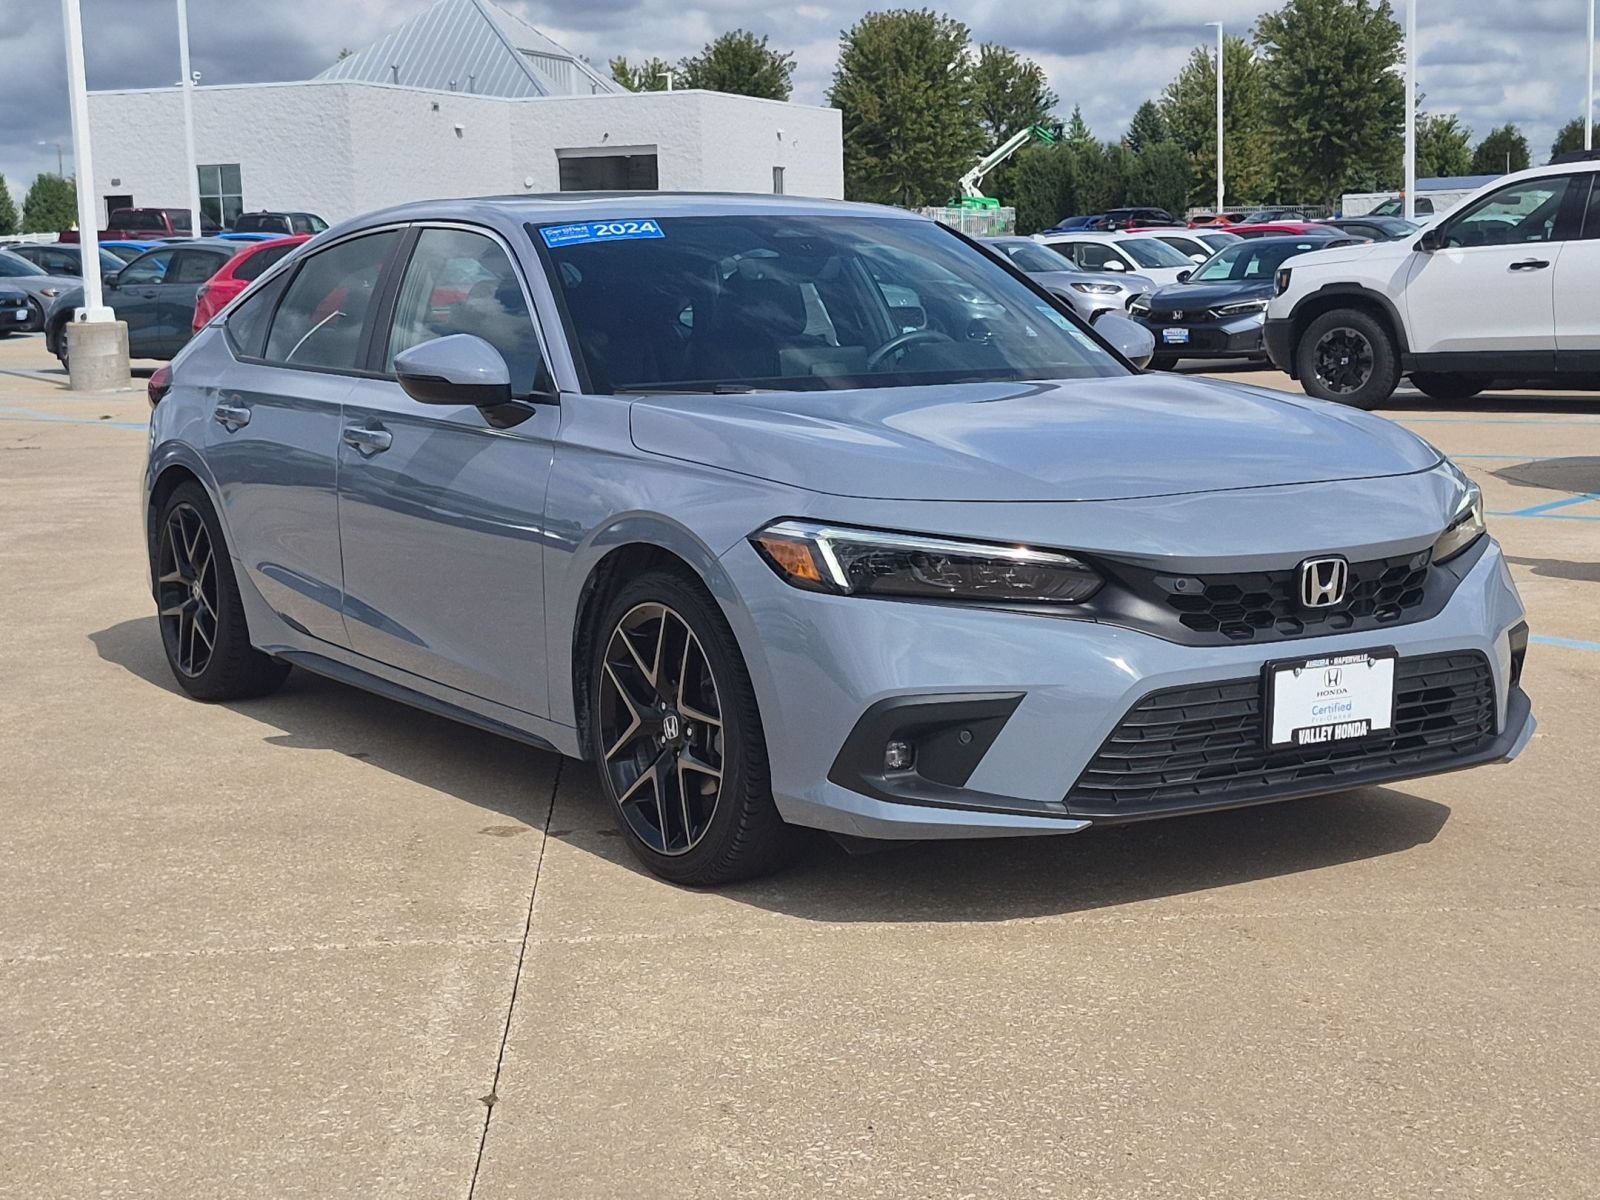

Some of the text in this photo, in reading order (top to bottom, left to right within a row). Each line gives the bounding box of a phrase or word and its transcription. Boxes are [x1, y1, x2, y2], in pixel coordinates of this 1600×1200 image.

[593, 222, 656, 236] 2024
[1316, 688, 1348, 697] HONDA
[1312, 700, 1352, 716] Certified
[1299, 721, 1367, 744] VALLEY HONDA
